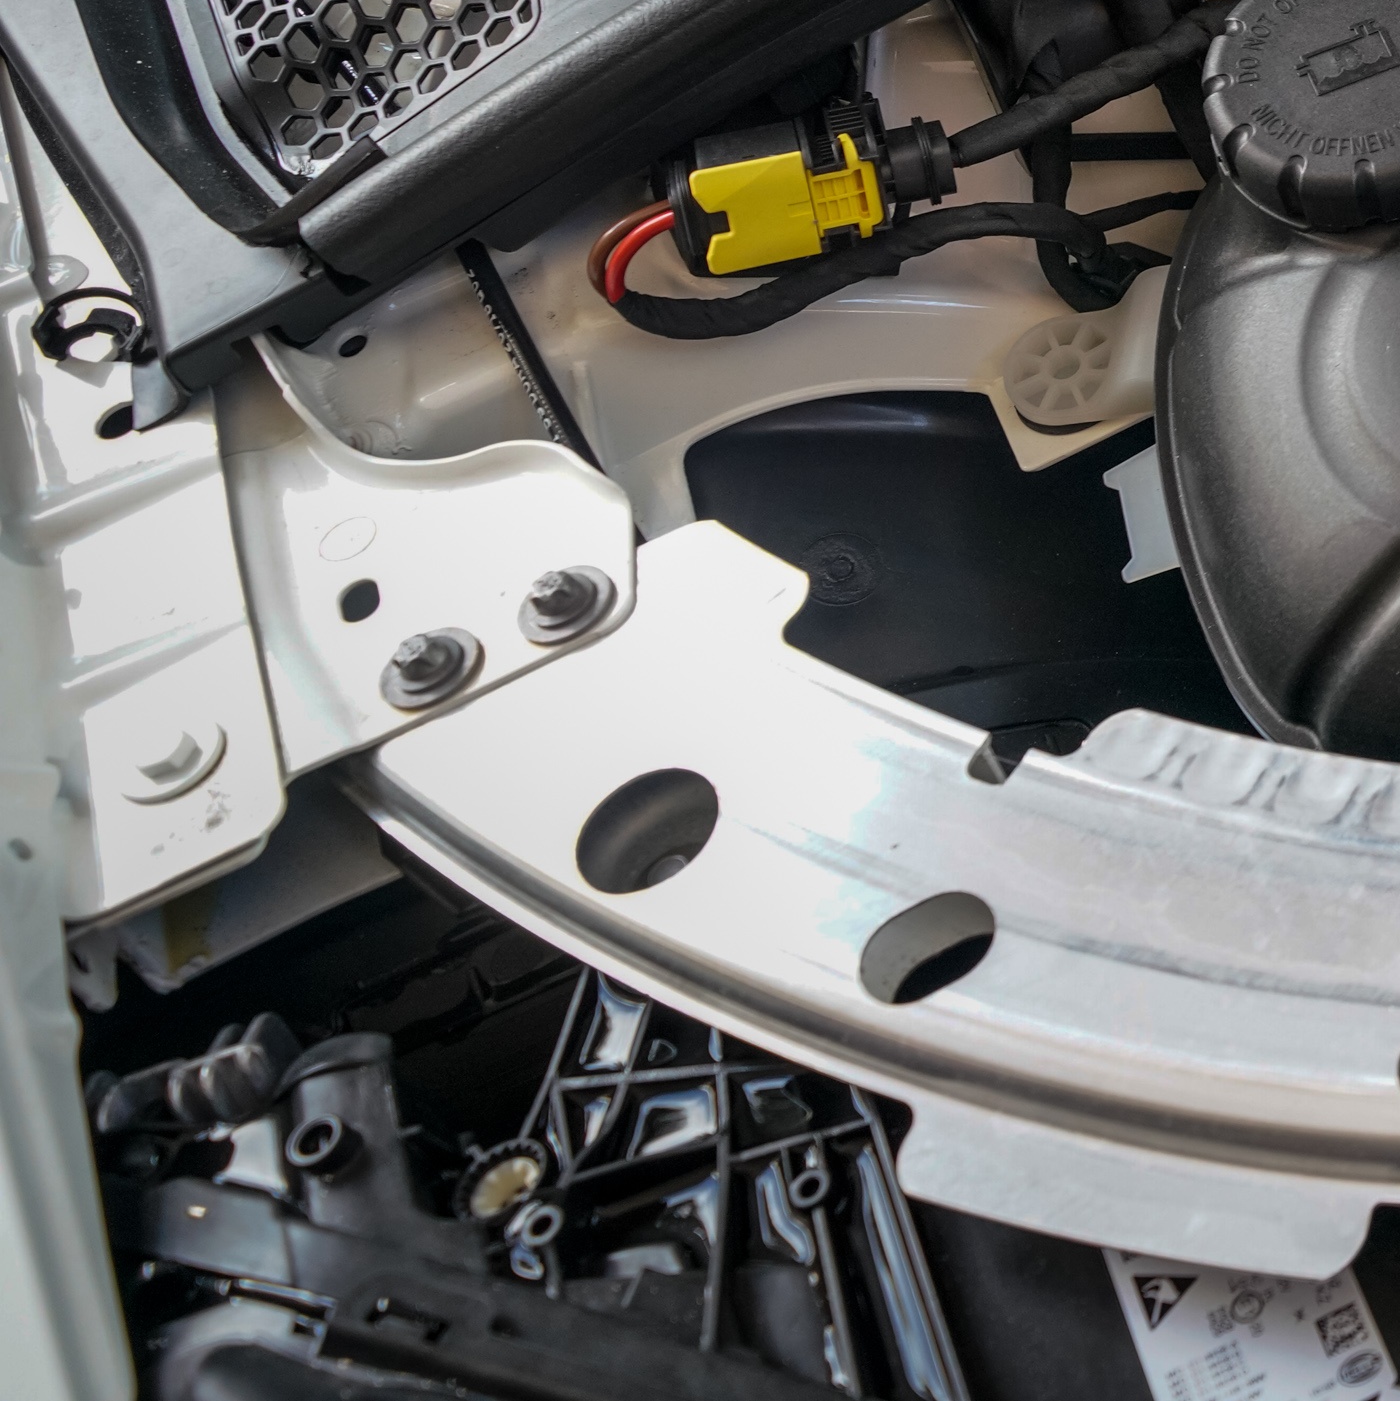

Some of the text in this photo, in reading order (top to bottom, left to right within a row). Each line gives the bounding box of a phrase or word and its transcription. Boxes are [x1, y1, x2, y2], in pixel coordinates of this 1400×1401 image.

[1242, 13, 1277, 51] NOT
[1236, 56, 1260, 84] DO
[1251, 103, 1310, 148] NICHT
